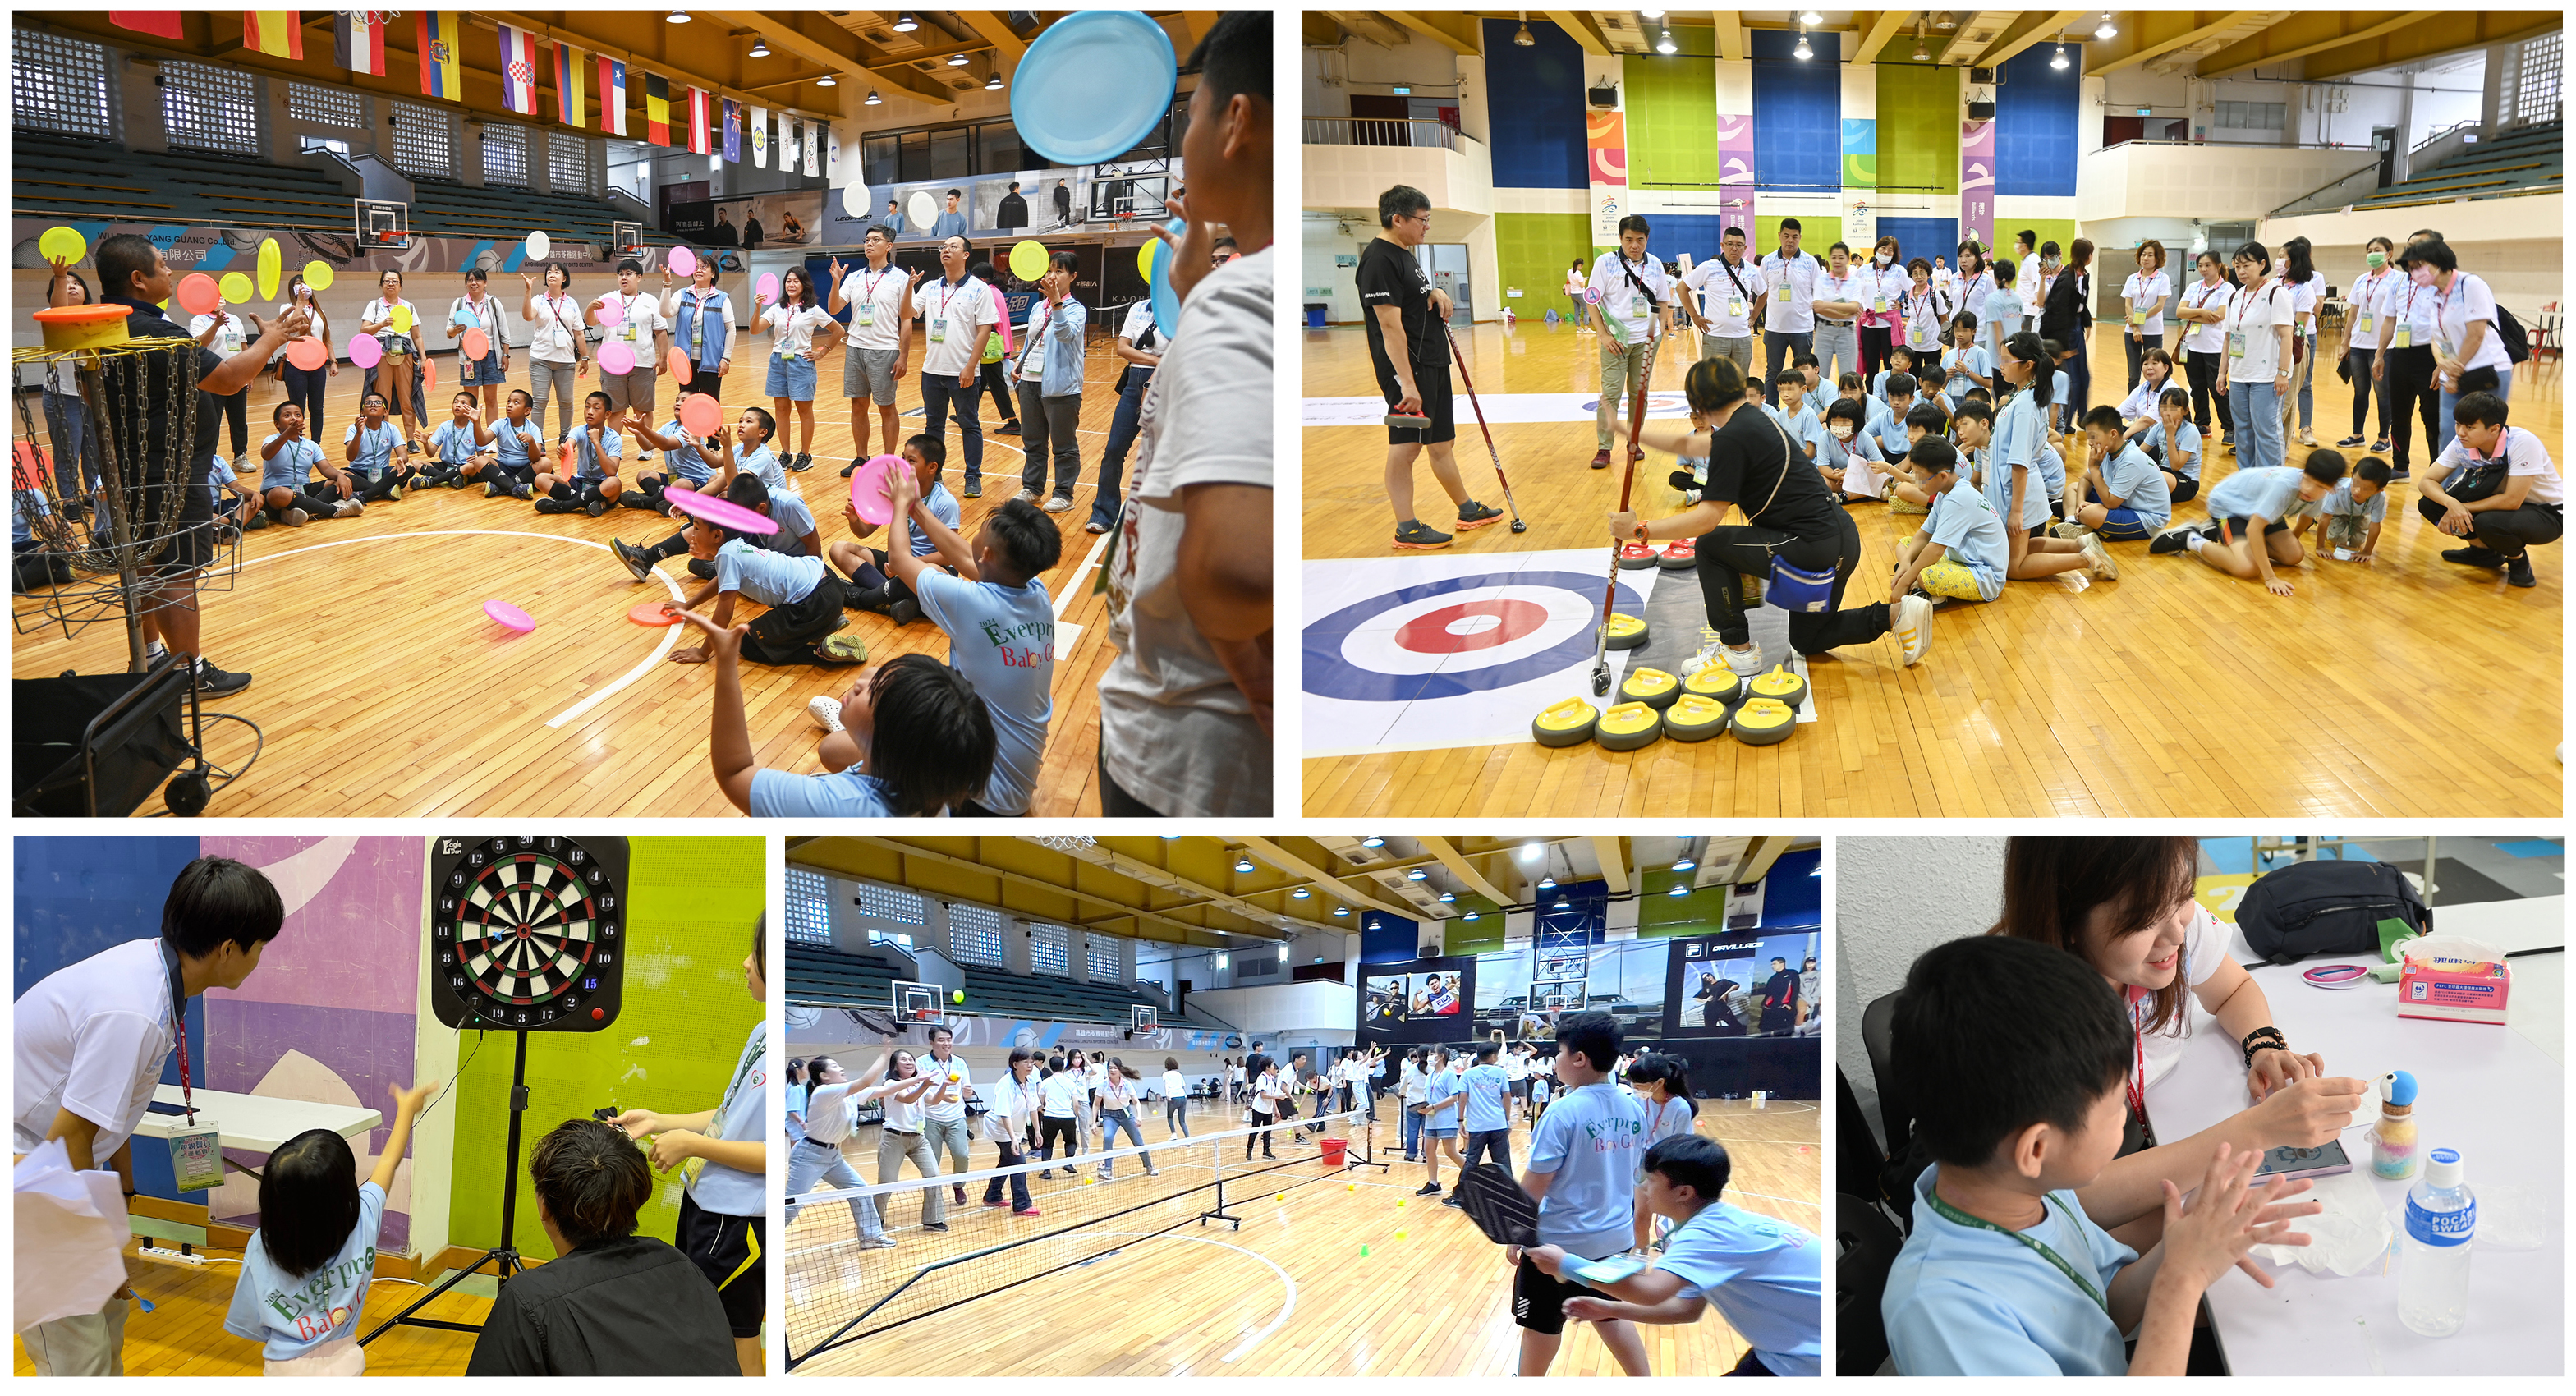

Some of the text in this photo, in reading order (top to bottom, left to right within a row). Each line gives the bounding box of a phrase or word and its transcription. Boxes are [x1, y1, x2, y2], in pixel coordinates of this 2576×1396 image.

[147, 234, 172, 243] YANG
[174, 236, 205, 245] GUANG
[548, 250, 594, 260] 雄市苓雅運動中心
[1589, 289, 1597, 300] 4
[979, 618, 996, 627] 2024
[999, 646, 1044, 670] Baby
[521, 836, 533, 844] 20
[550, 838, 556, 848] 1
[496, 840, 503, 851] 5
[471, 854, 483, 864] 12
[571, 851, 584, 861] 18
[454, 875, 463, 884] 9
[590, 871, 599, 881] 4
[441, 899, 452, 909] 14
[601, 897, 613, 907] 13
[438, 927, 448, 937] 11
[605, 926, 613, 936] 6
[443, 953, 451, 962] 8
[599, 953, 611, 963] 10
[452, 977, 463, 987] 16
[585, 978, 597, 989] 15
[471, 996, 479, 1005] 7
[567, 998, 576, 1008] 2
[1436, 994, 1451, 1006] FILA
[492, 1008, 503, 1018] 19
[517, 1013, 526, 1023] 3
[542, 1011, 553, 1020] 17
[264, 1288, 282, 1306] 2024
